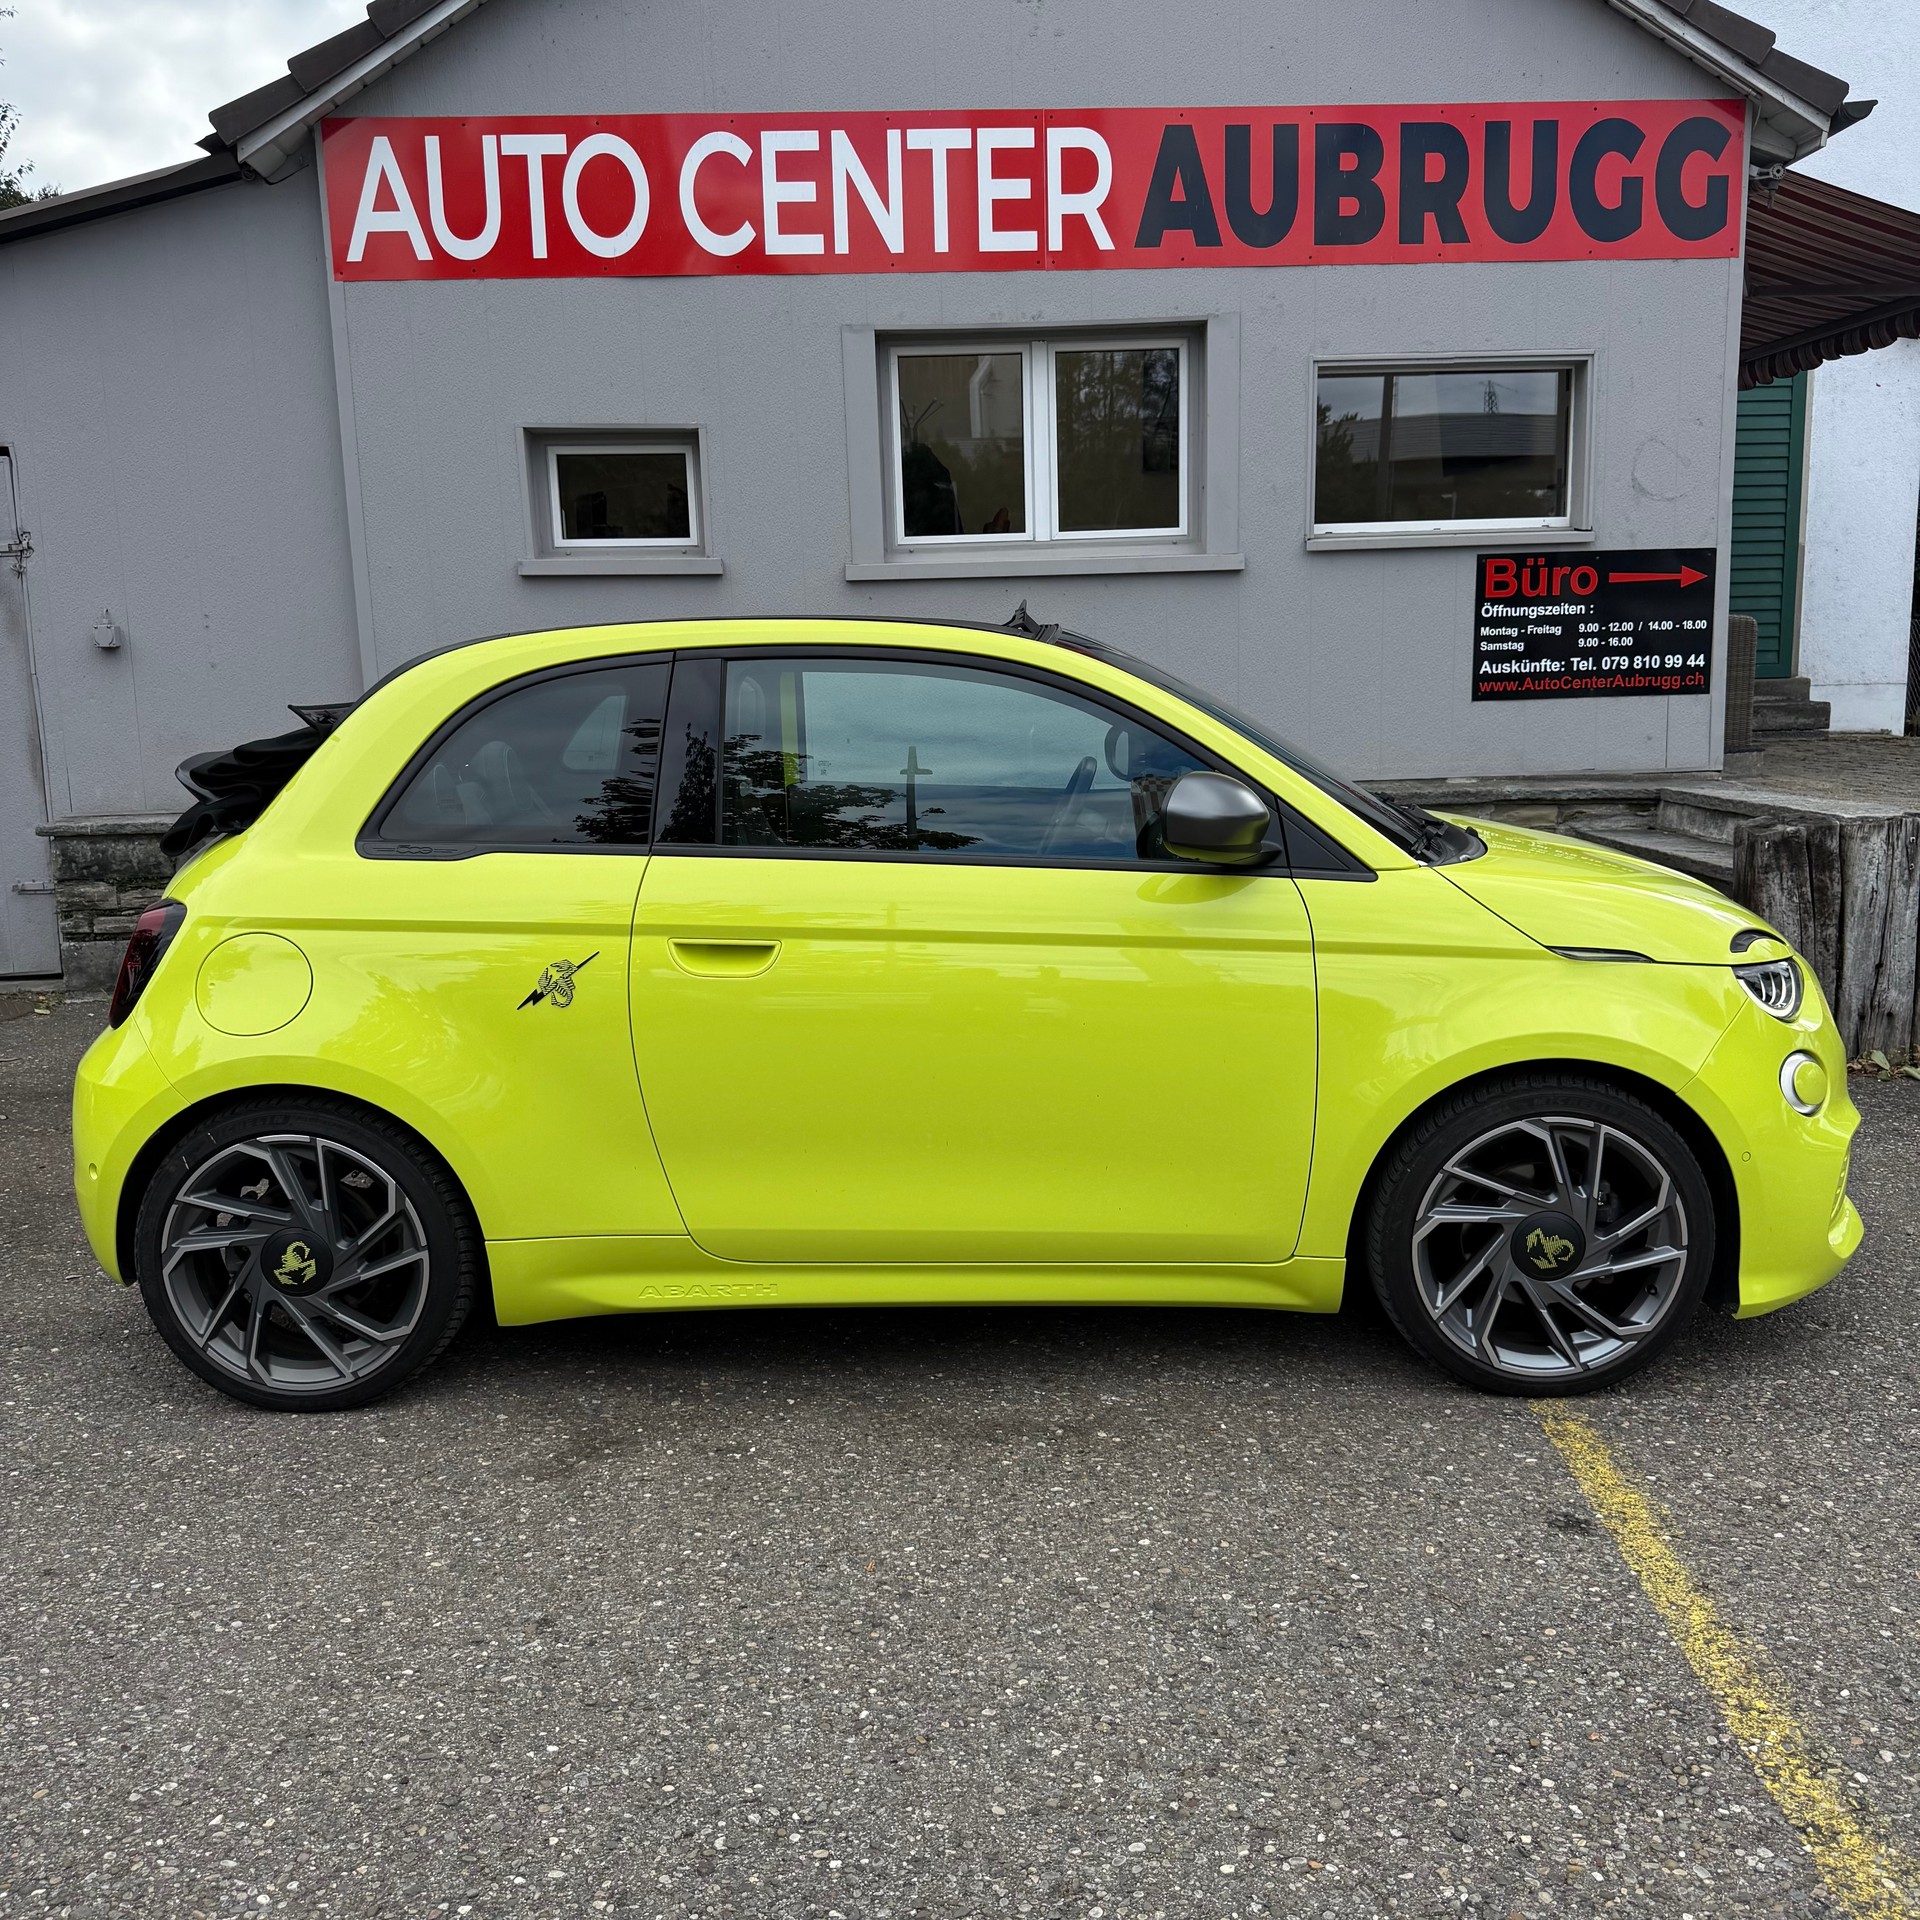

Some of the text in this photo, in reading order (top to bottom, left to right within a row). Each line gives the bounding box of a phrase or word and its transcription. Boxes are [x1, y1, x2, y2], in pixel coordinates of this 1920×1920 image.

[346, 116, 1732, 262] AUTO CENTER AUBRUGG
[1485, 558, 1599, 598] Büro
[1481, 603, 1586, 619] Öffnungszeiten
[1480, 626, 1518, 638] Montag
[1527, 624, 1562, 636] Freitag
[1578, 623, 1599, 633] 9.00
[1608, 622, 1634, 632] 12.00
[1648, 620, 1673, 631] 14.00
[1682, 619, 1707, 630] 18.00
[1480, 640, 1525, 652] Samstag
[1578, 638, 1599, 648] 9.00
[1608, 637, 1633, 647] 16.00
[1479, 653, 1706, 674] Auskünfte: Tel. 079 810 99 44
[1479, 672, 1705, 692] www.AutoCenterAubrugg.ch
[638, 1283, 778, 1299] ABARTH
